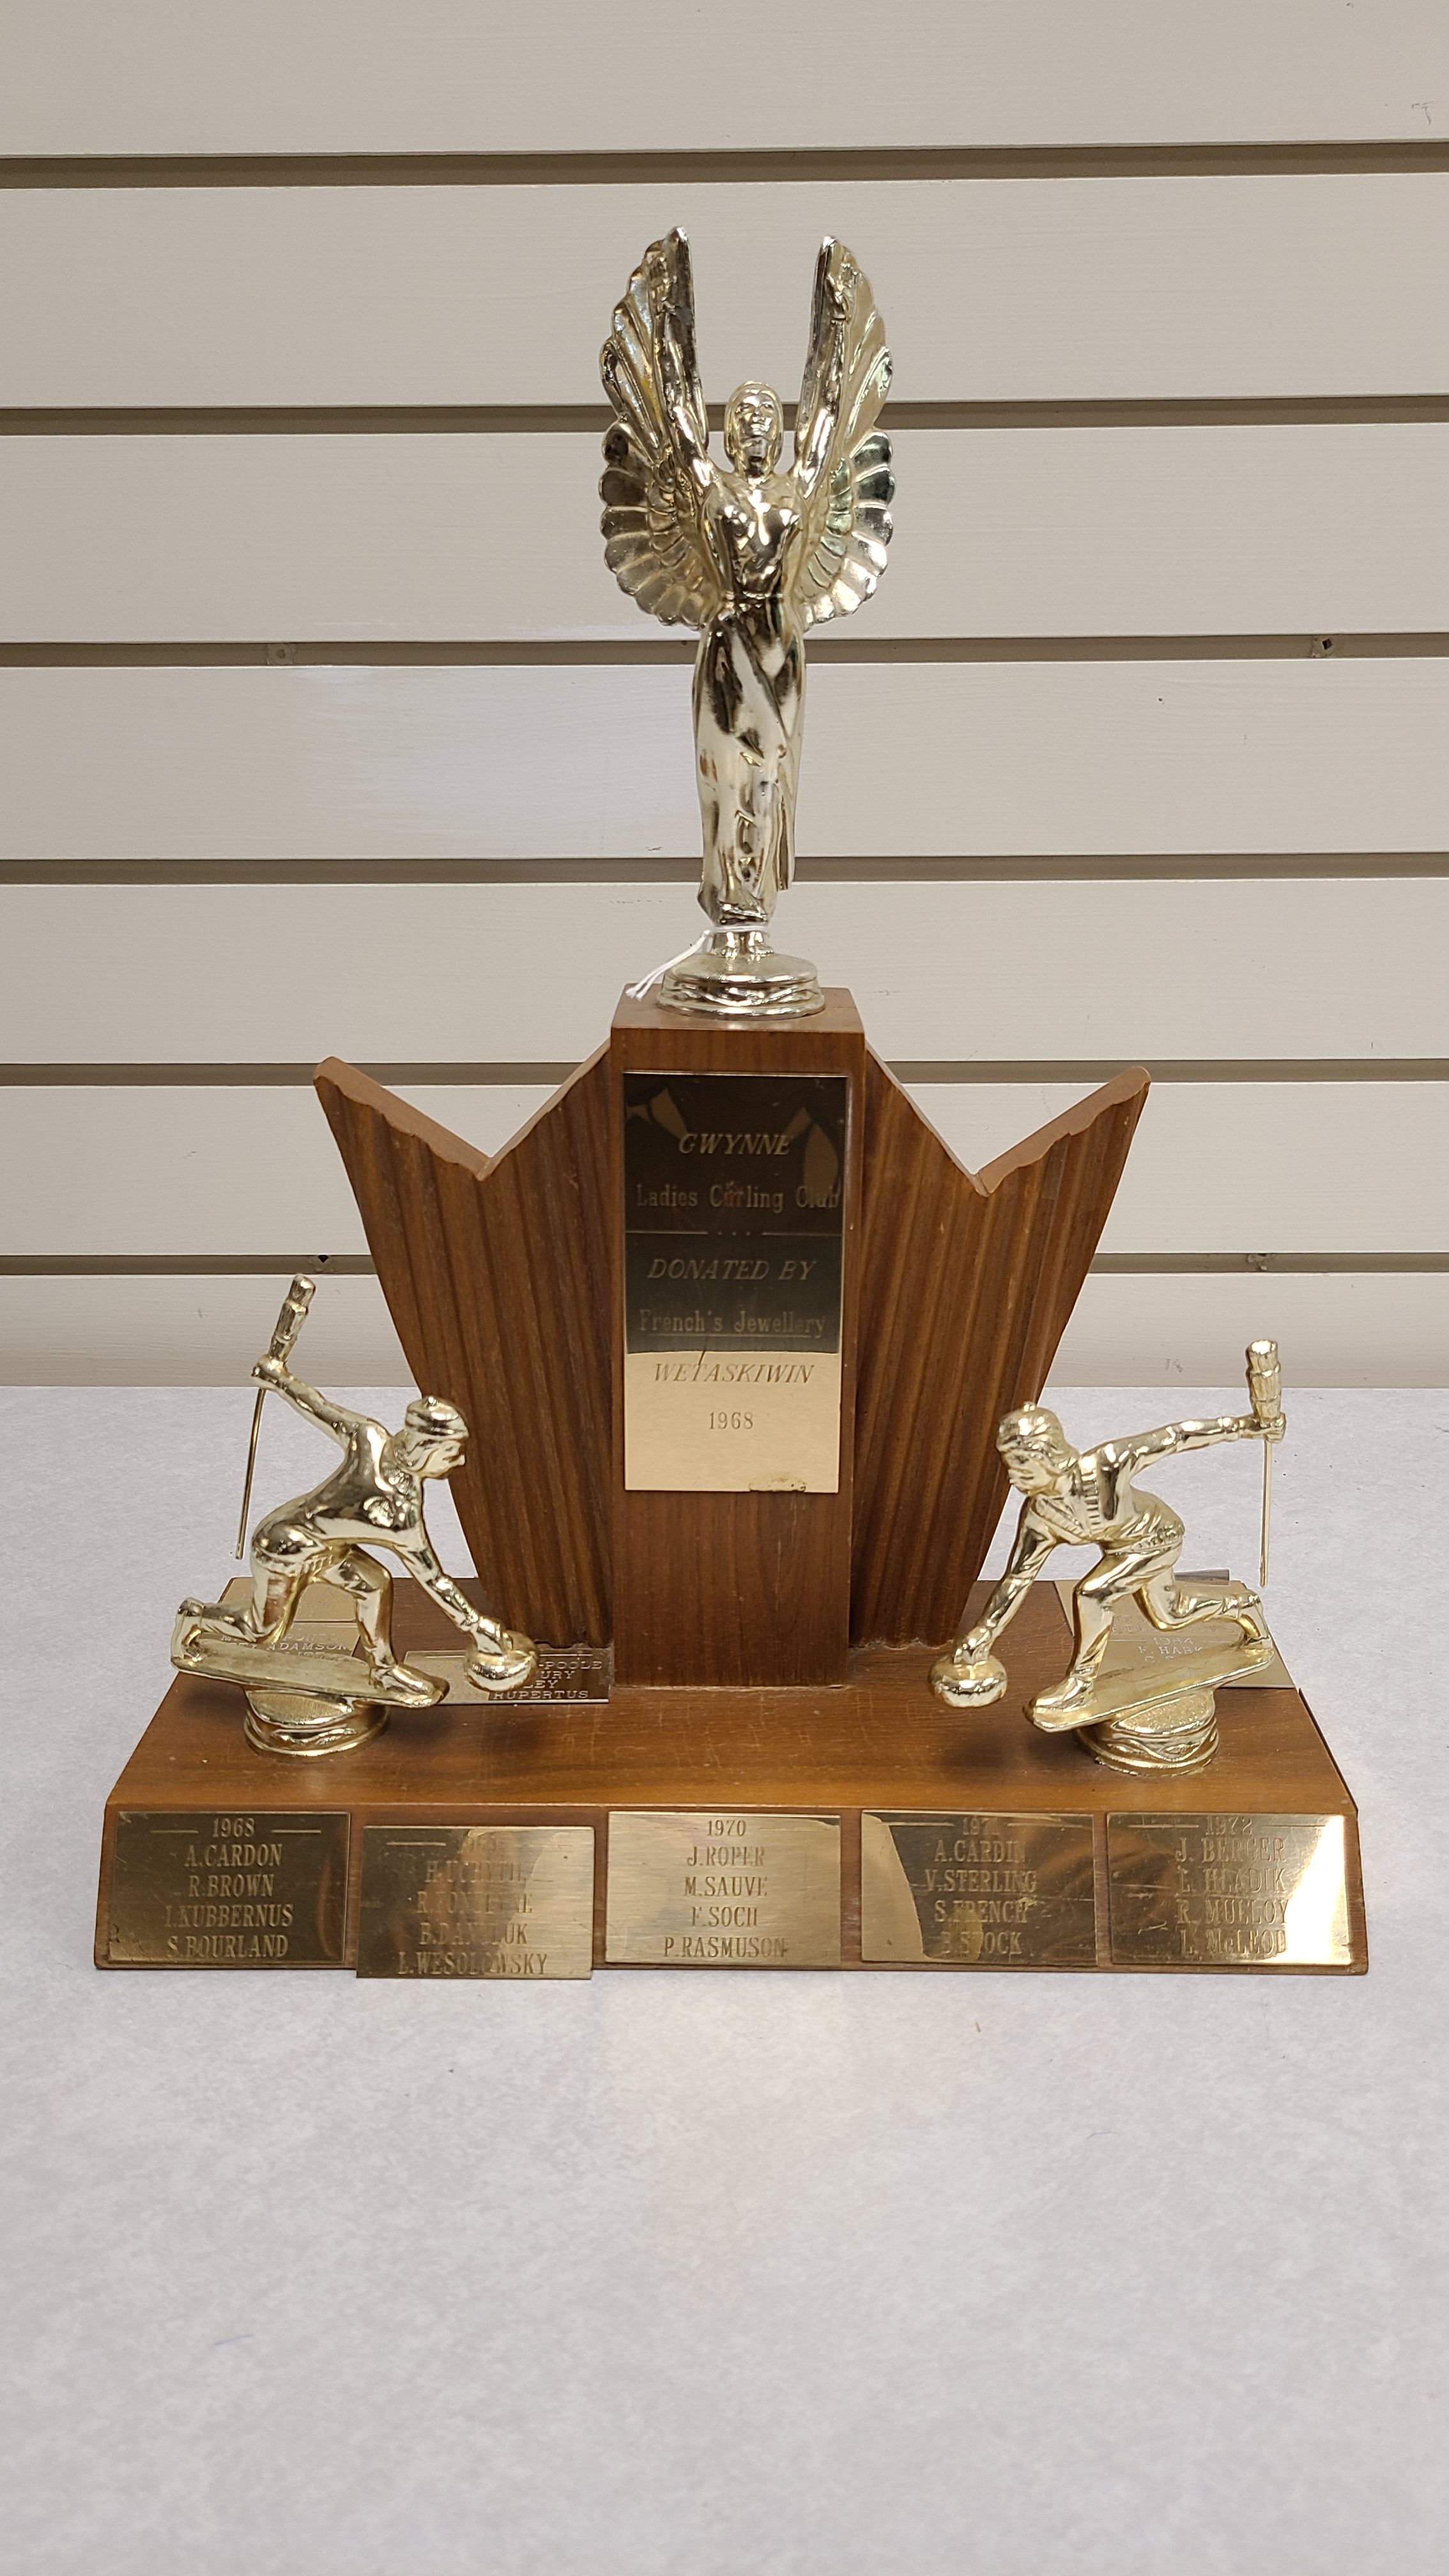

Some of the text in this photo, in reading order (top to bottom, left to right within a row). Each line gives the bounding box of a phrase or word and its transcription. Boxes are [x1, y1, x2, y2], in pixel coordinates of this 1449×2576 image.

[678, 1133, 794, 1155] GWYNNE
[637, 1184, 698, 1207] Ladies
[647, 1259, 817, 1280] DONATED BY
[640, 1309, 826, 1339] French's Jewellery
[654, 1363, 815, 1384] WETASKIWIN
[709, 1411, 755, 1430] 1968
[212, 1818, 255, 1838] 1968
[707, 1819, 747, 1837] 1970
[1206, 1816, 1253, 1836] 1972
[184, 1844, 282, 1867] A.CARDON
[686, 1846, 765, 1867] J.ROPER
[1201, 1837, 1287, 1863] BERGER
[924, 1869, 1037, 1893] V.STERLING
[664, 1936, 786, 1958] P.RASMUSON
